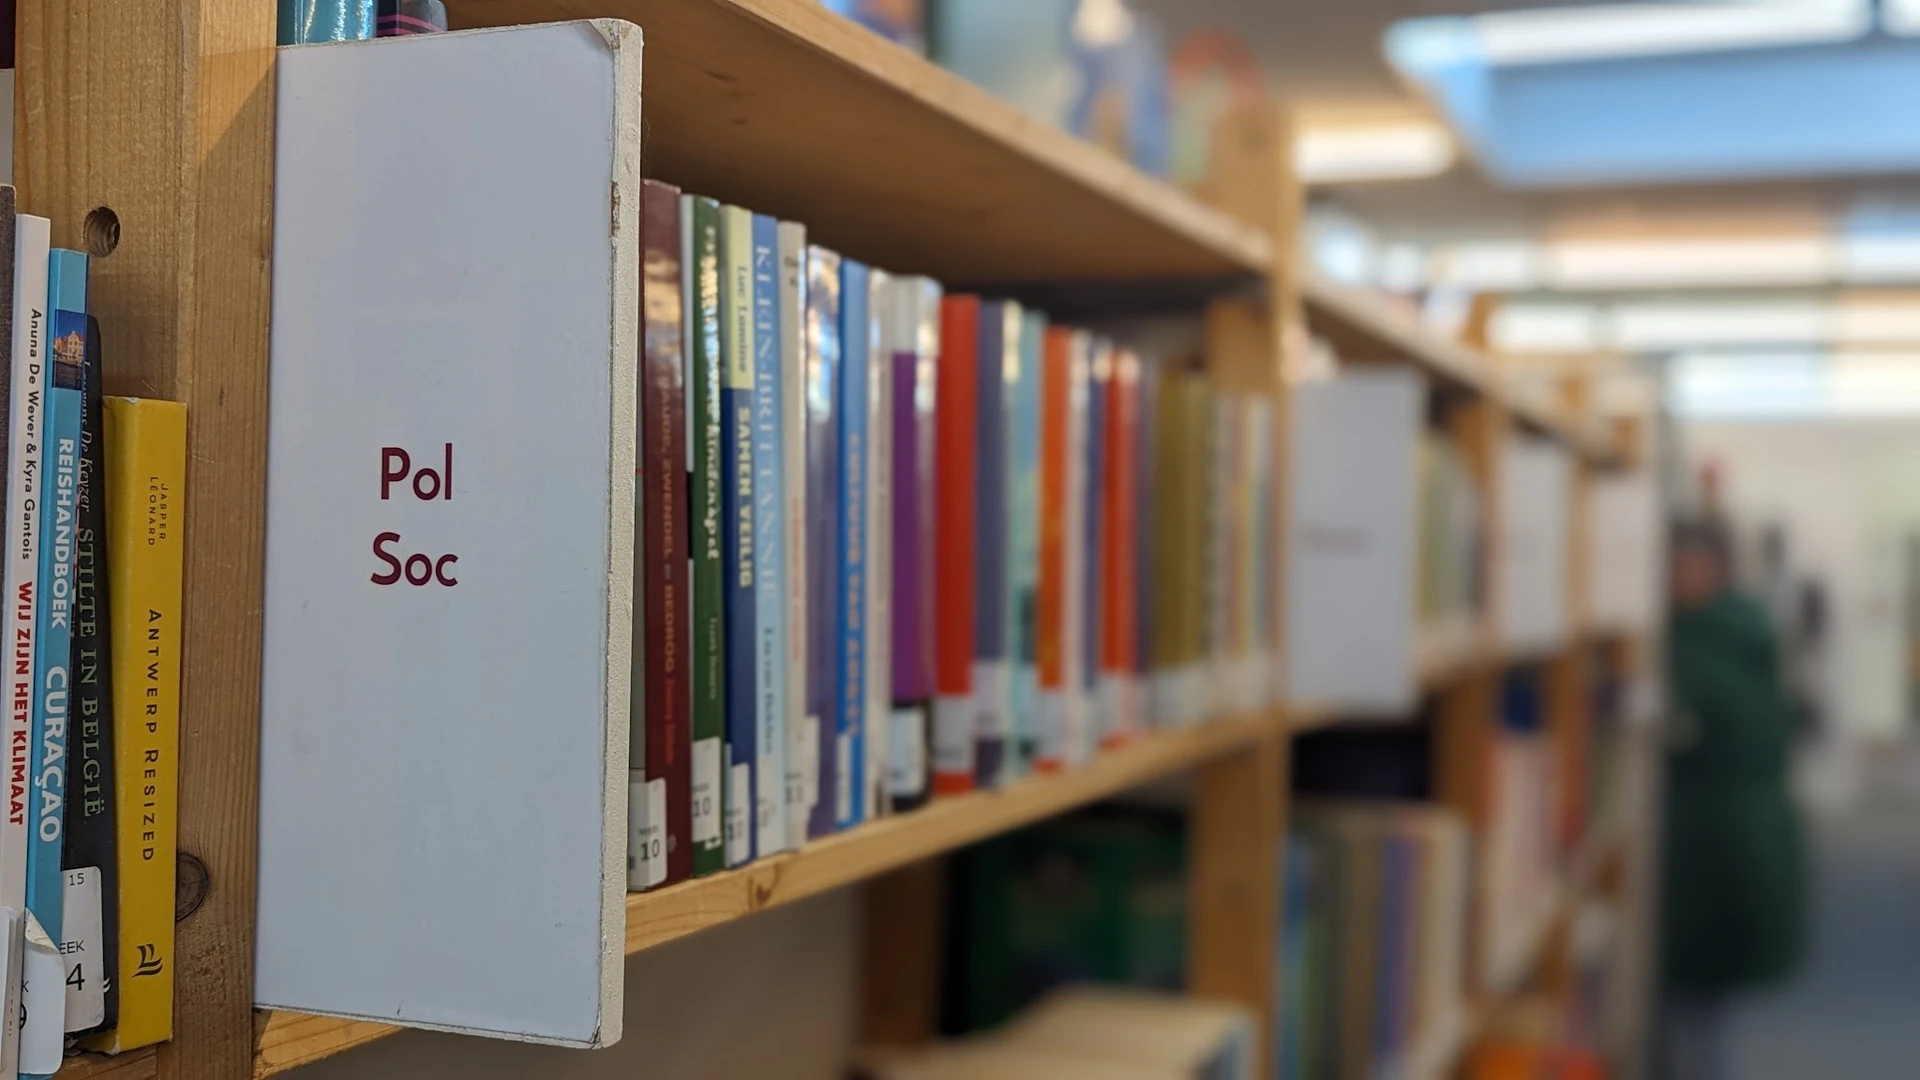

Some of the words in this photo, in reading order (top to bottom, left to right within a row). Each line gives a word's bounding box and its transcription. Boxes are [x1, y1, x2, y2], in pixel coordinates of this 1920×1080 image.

[29, 308, 42, 358] Anuna
[28, 363, 40, 385] De
[26, 390, 39, 439] Wever
[81, 430, 93, 453] De
[26, 443, 37, 454] &
[381, 442, 453, 501] Pol
[738, 407, 752, 496] SAMEN
[23, 460, 37, 493] Kyra
[79, 458, 93, 513] Keyzer
[22, 498, 36, 560] Gantois
[51, 438, 75, 629] REISHANDBOEK
[147, 476, 159, 546] LÉONARD
[158, 483, 169, 540] JASPER
[662, 459, 673, 560] ZWENDEL
[370, 531, 459, 587] Soc
[739, 504, 753, 588] VEILIG
[17, 581, 33, 621] WIJ
[78, 528, 96, 637] STILTE
[16, 628, 31, 675] ZIJN
[664, 584, 675, 674] BEDROG
[80, 648, 98, 685] IN
[145, 608, 162, 734] ANTWERP
[13, 682, 29, 723] HET
[9, 730, 27, 826] KLIMAAT
[35, 665, 68, 843] CURAÇAO
[81, 697, 105, 817] BELGIË
[142, 749, 159, 861] RESIZED
[692, 796, 711, 818] 10
[640, 838, 660, 861] 10
[68, 872, 85, 886] 15
[59, 940, 85, 955] EEK
[65, 963, 86, 991] 4
